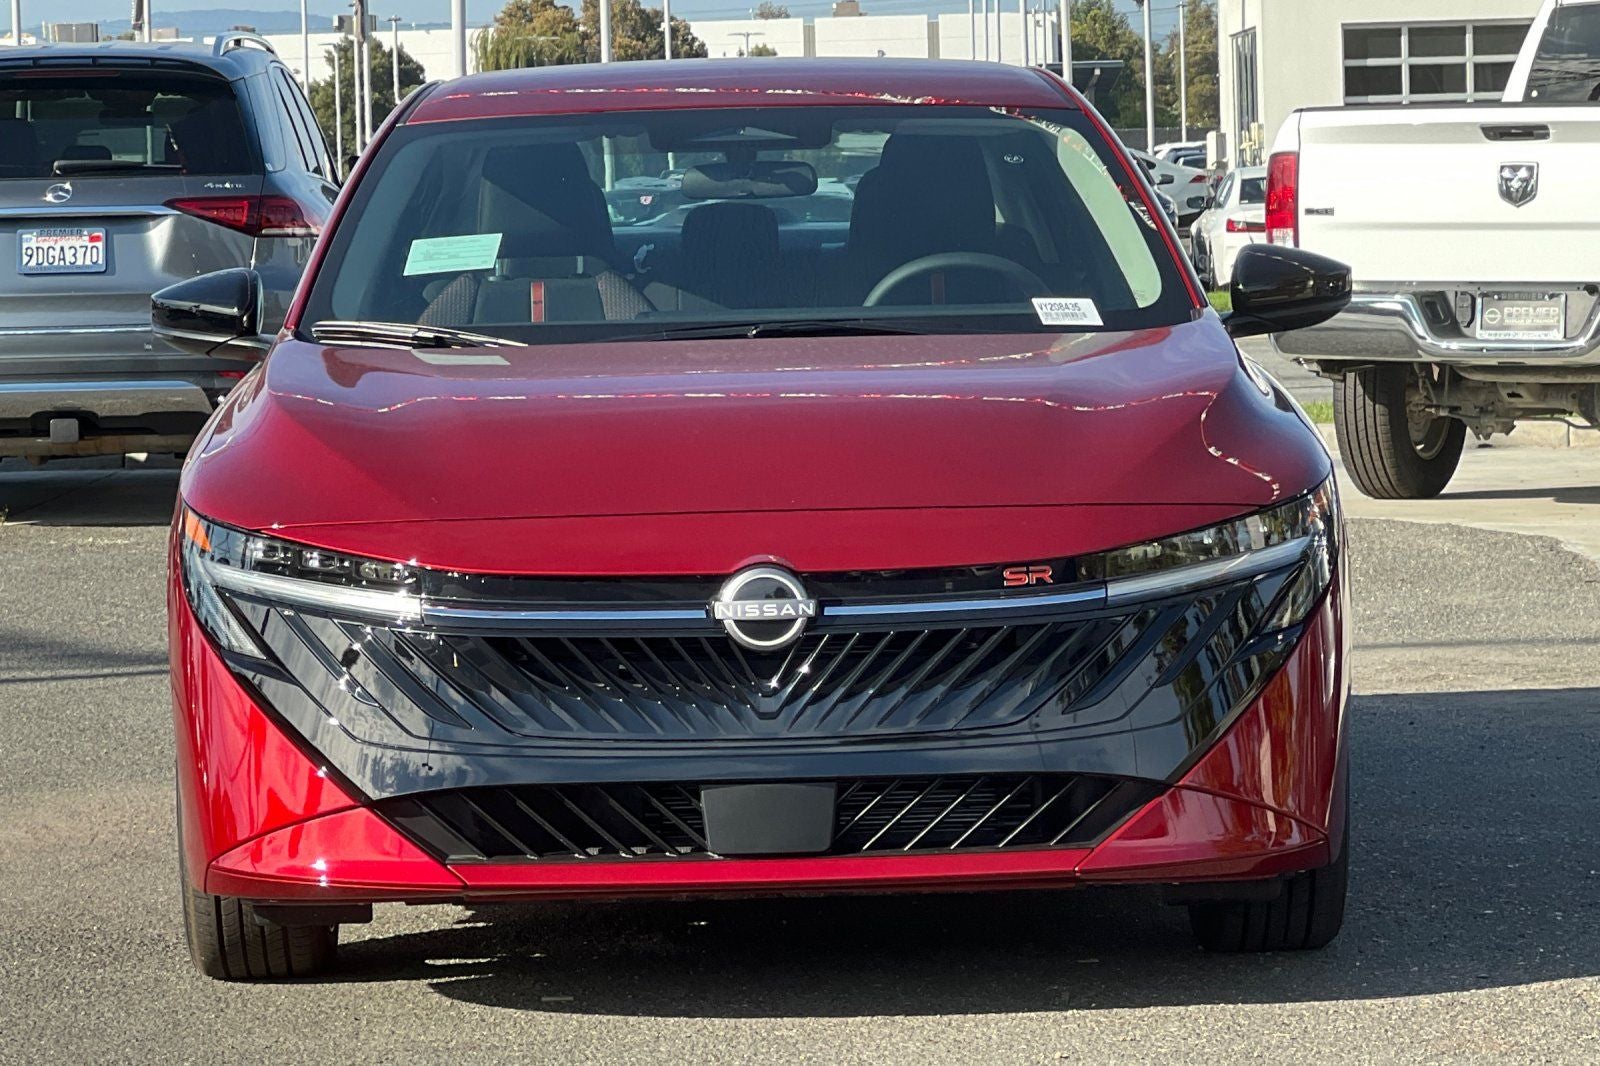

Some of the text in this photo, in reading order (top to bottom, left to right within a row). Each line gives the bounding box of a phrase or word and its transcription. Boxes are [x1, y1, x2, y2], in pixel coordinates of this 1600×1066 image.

[40, 228, 83, 237] PREMIER
[24, 245, 100, 266] 9DGA370
[1503, 306, 1559, 319] PREMIER
[1003, 565, 1053, 587] SR
[719, 602, 814, 617] NISSAN
